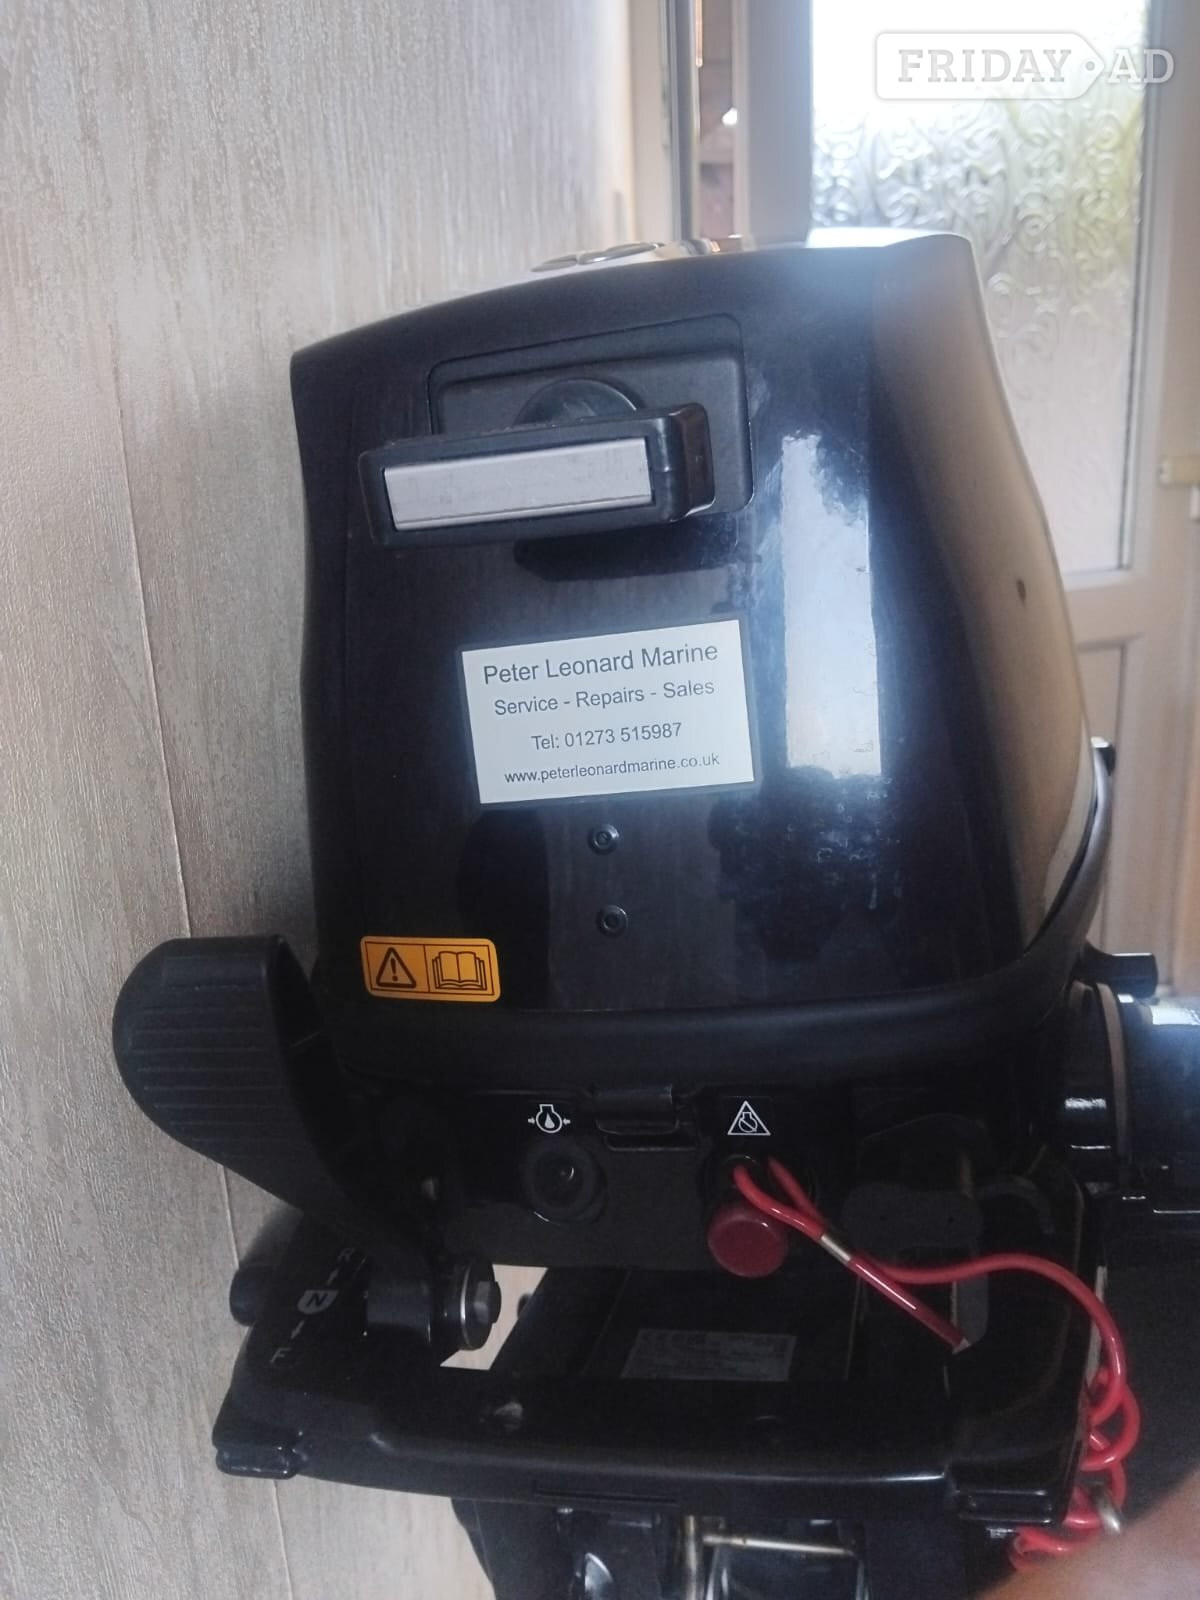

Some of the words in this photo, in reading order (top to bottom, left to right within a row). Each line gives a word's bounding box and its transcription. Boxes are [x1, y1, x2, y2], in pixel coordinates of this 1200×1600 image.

[483, 664, 539, 685] Peter
[545, 650, 634, 679] Leonard
[641, 643, 718, 668] Marine
[494, 695, 558, 716] Service
[575, 687, 645, 709] Repairs
[662, 680, 715, 699] Sales
[531, 733, 560, 751] Tel:
[564, 728, 616, 748] 01273
[620, 722, 682, 743] 515987
[504, 752, 720, 784] www.peterleonardmarine.co.uk
[306, 1293, 328, 1307] N
[270, 1347, 291, 1363] F
